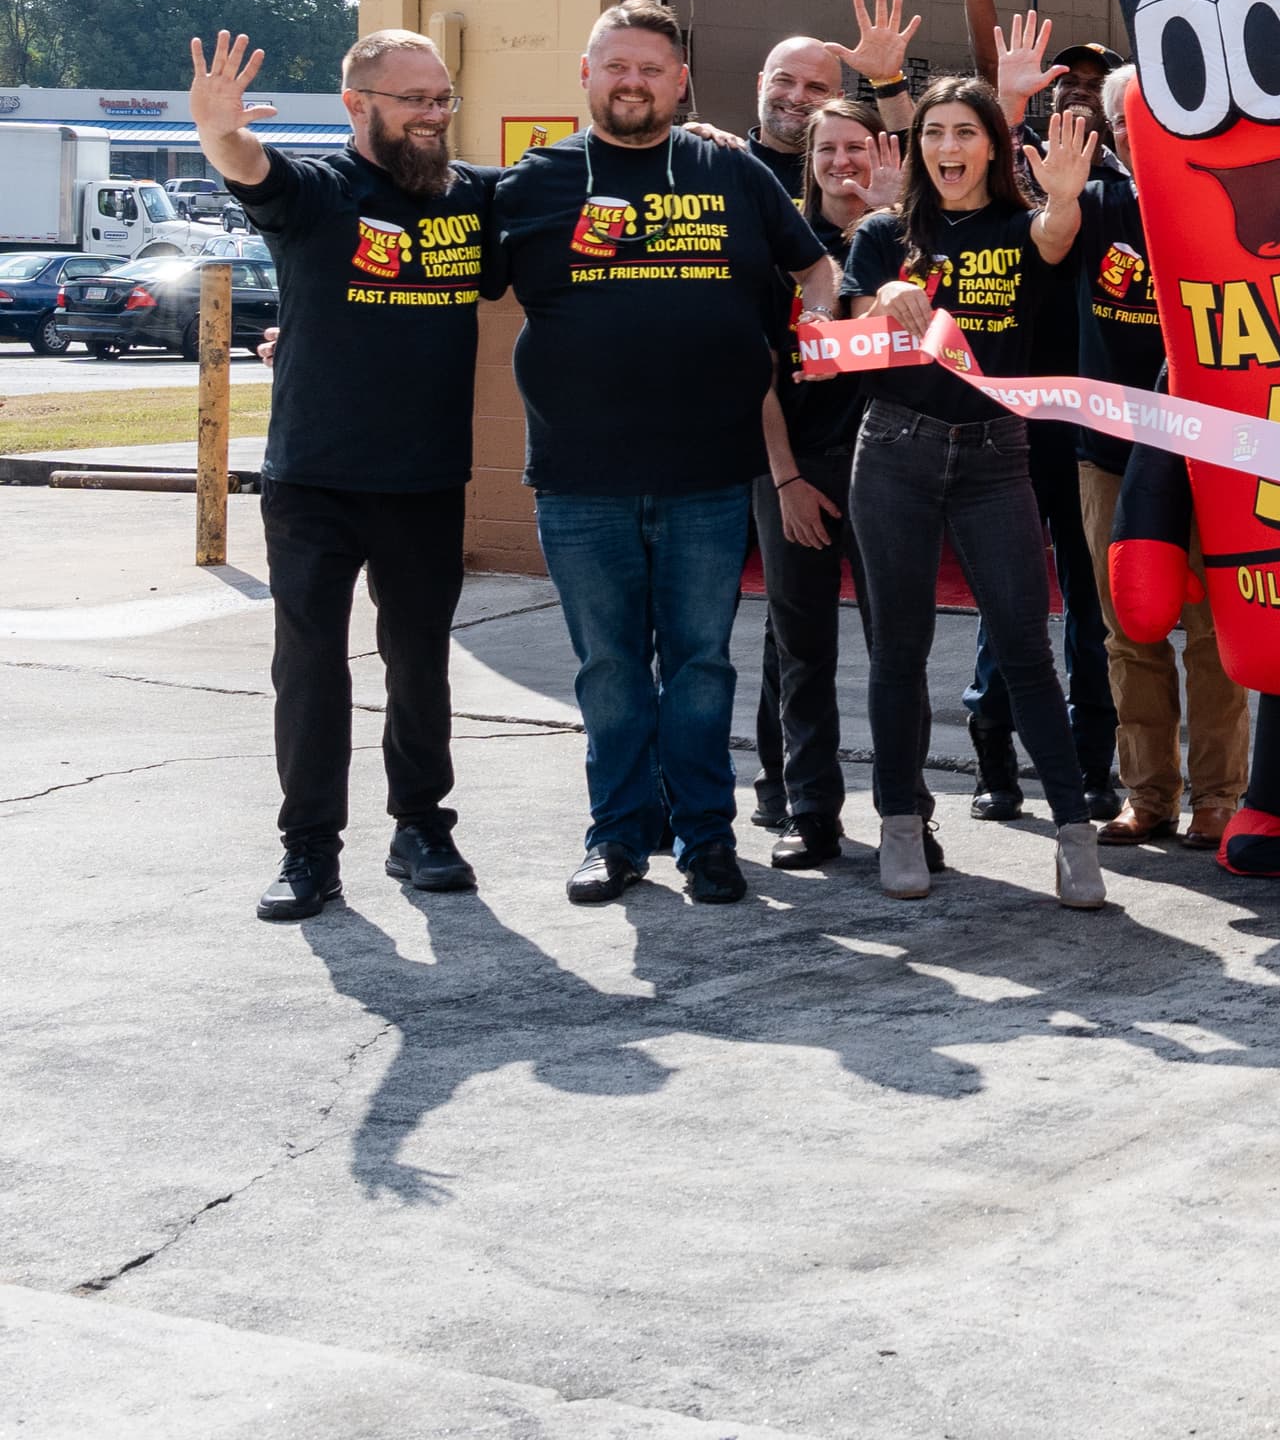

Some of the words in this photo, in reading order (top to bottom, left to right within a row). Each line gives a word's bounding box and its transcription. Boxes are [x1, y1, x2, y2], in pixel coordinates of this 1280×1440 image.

[581, 204, 623, 222] TAKE
[643, 193, 726, 221] 300TH
[360, 222, 398, 249] TAKE
[418, 214, 480, 248] 300TH
[367, 243, 389, 263] 5
[1106, 247, 1135, 269] TAKE
[571, 268, 607, 283] FAST.
[609, 266, 678, 279] FRIENDLY.
[680, 266, 732, 279] SIMPLE.
[1103, 265, 1125, 285] 5
[347, 289, 386, 304] FAST.
[389, 292, 453, 305] FRIENDLY.
